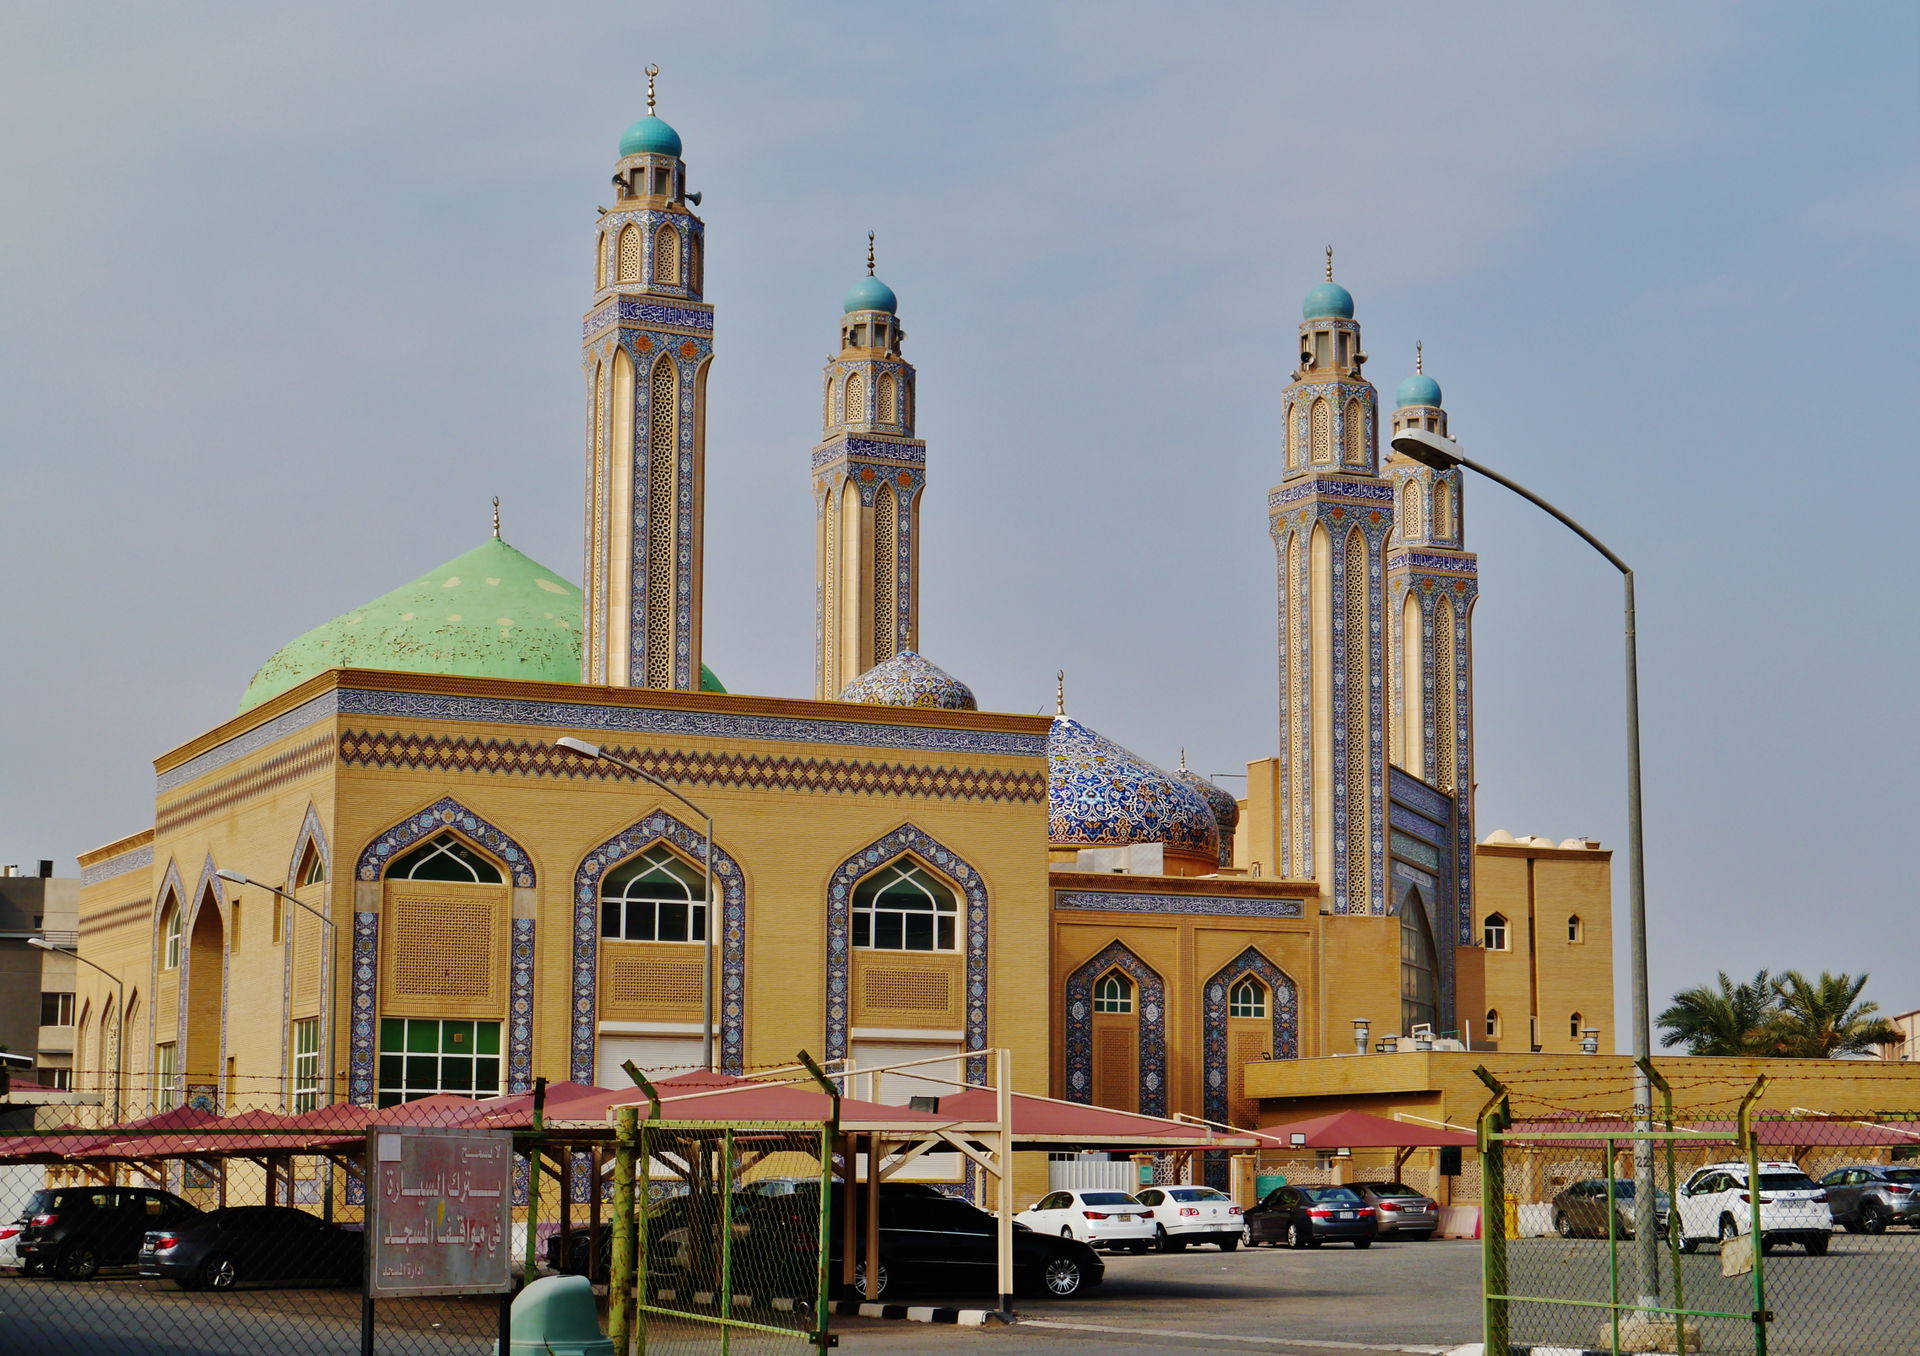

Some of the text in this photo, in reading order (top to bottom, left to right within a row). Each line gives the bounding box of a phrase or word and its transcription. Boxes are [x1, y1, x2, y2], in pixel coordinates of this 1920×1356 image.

[495, 1144, 501, 1159] لا
[386, 1169, 501, 1208] بترك السيارة
[383, 1216, 434, 1253] المسجد
[487, 1215, 501, 1258] في
